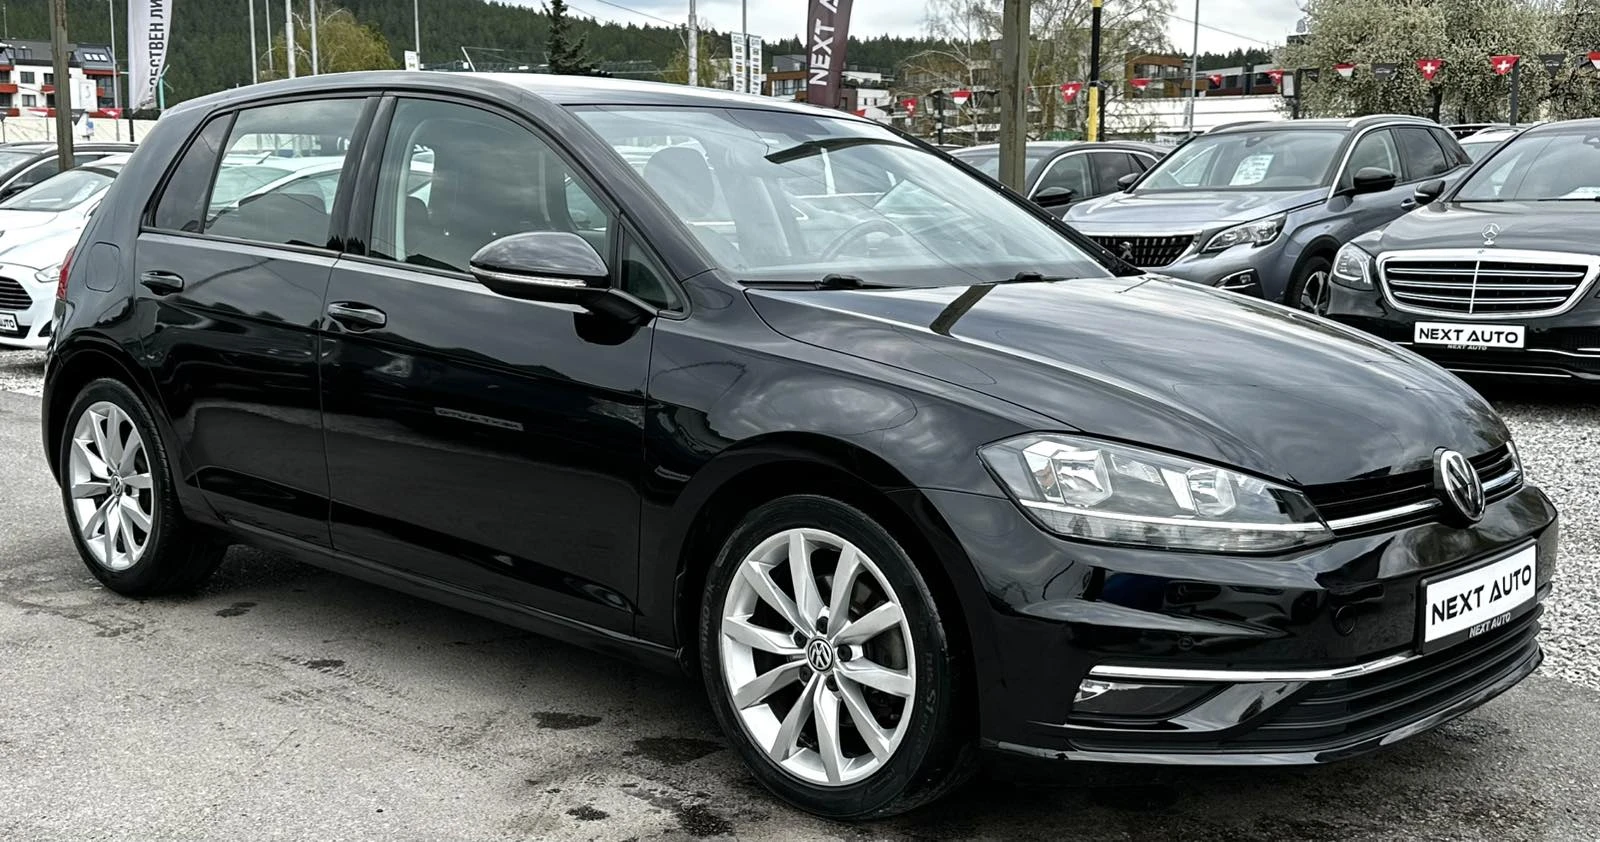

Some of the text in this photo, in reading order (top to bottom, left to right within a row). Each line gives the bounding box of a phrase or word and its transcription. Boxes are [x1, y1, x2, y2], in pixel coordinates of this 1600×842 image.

[809, 18, 835, 86] NEXT
[1419, 327, 1518, 344] NEXT AUTO
[1432, 564, 1531, 625] NEXT AUTO
[1469, 612, 1511, 638] NEXT AUTO
